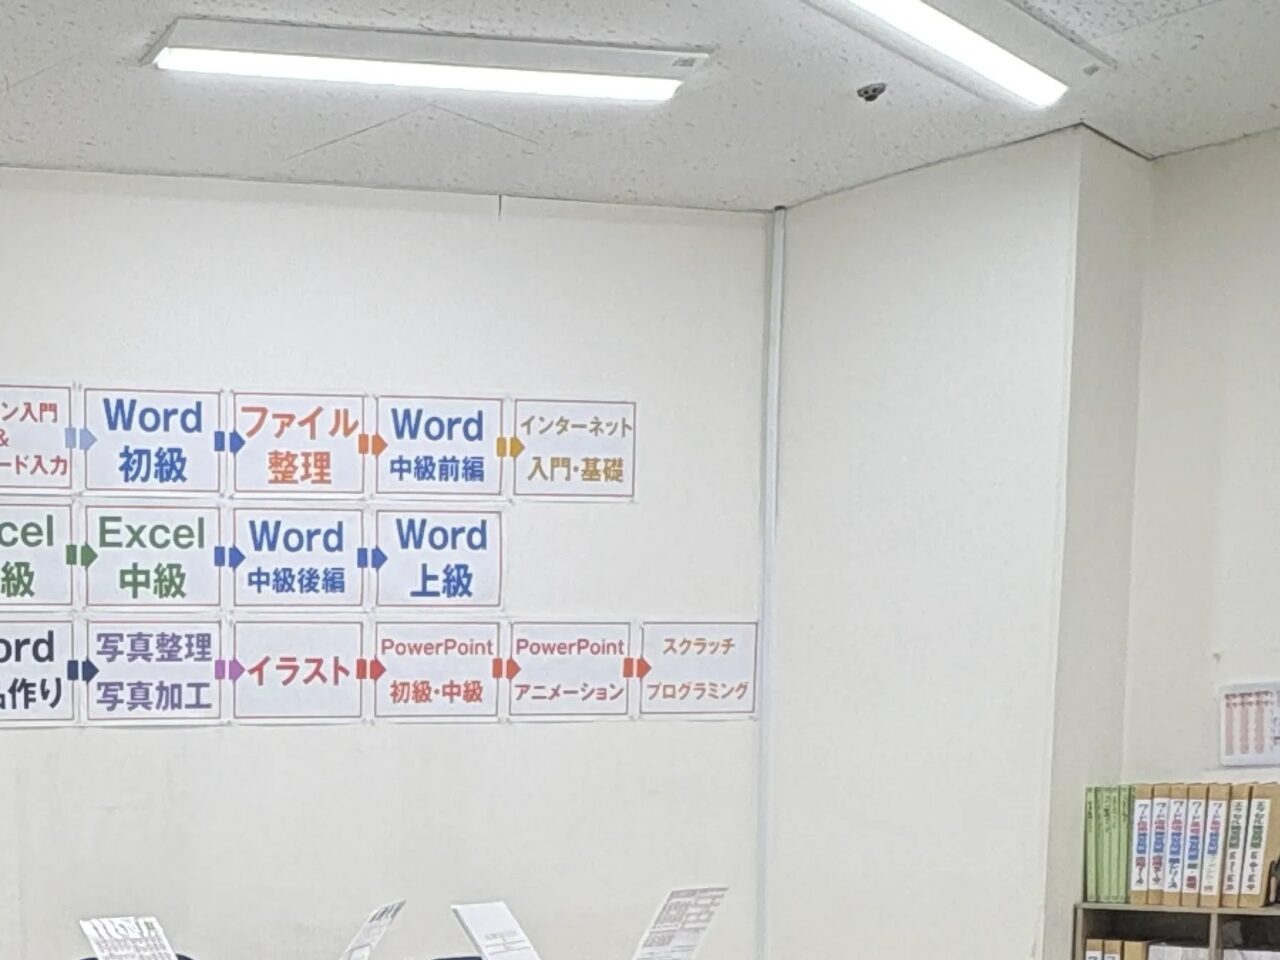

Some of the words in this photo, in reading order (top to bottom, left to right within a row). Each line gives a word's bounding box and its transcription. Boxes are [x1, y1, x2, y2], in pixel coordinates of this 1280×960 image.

[103, 399, 202, 433] Word
[240, 406, 358, 439] ファイル
[392, 409, 484, 441] Word
[520, 415, 633, 438] インターネット
[118, 447, 187, 483] 初級
[268, 451, 331, 484] 整理
[390, 455, 484, 482] 中級前編
[527, 457, 624, 482] 入門・基礎
[99, 516, 205, 549] Excel
[249, 520, 343, 552] Word
[396, 518, 487, 551] Word
[119, 563, 186, 598] 中級
[247, 568, 345, 594] 中級後編
[410, 564, 473, 598] 上級
[96, 633, 212, 663] 写真整理
[381, 639, 493, 657] PowerPoint
[516, 639, 624, 657] PowerPoint
[663, 638, 735, 656] スクラッチ
[248, 657, 350, 685] イラスト
[96, 681, 212, 711] 写真加工
[390, 681, 483, 703] 初級・中級
[514, 683, 624, 702] アニメーション
[648, 682, 749, 701] プログラミング
